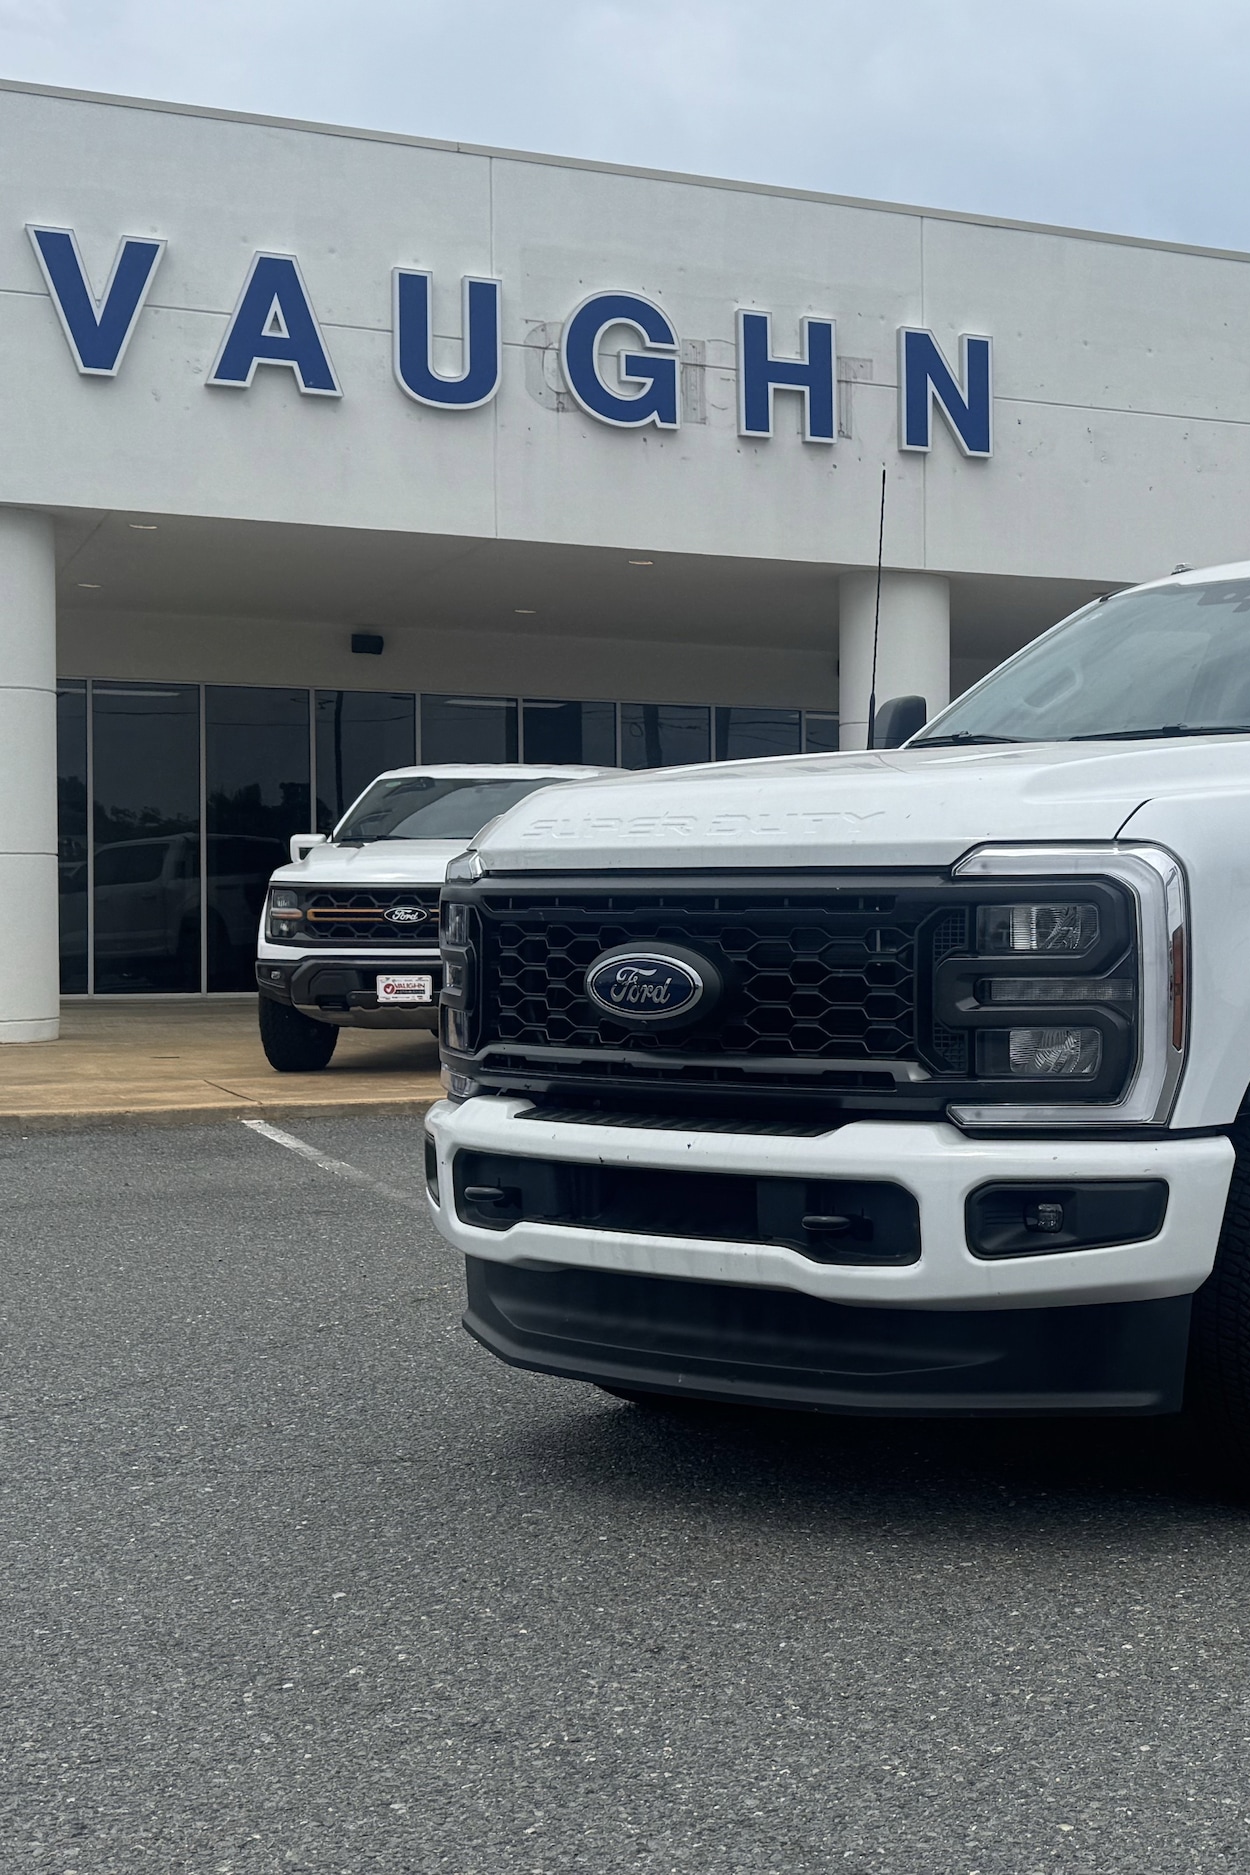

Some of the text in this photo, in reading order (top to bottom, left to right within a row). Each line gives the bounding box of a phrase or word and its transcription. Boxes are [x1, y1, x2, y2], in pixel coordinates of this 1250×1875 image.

[25, 223, 994, 459] VAUGHN
[392, 908, 419, 920] Ford
[610, 966, 673, 1004] Ford
